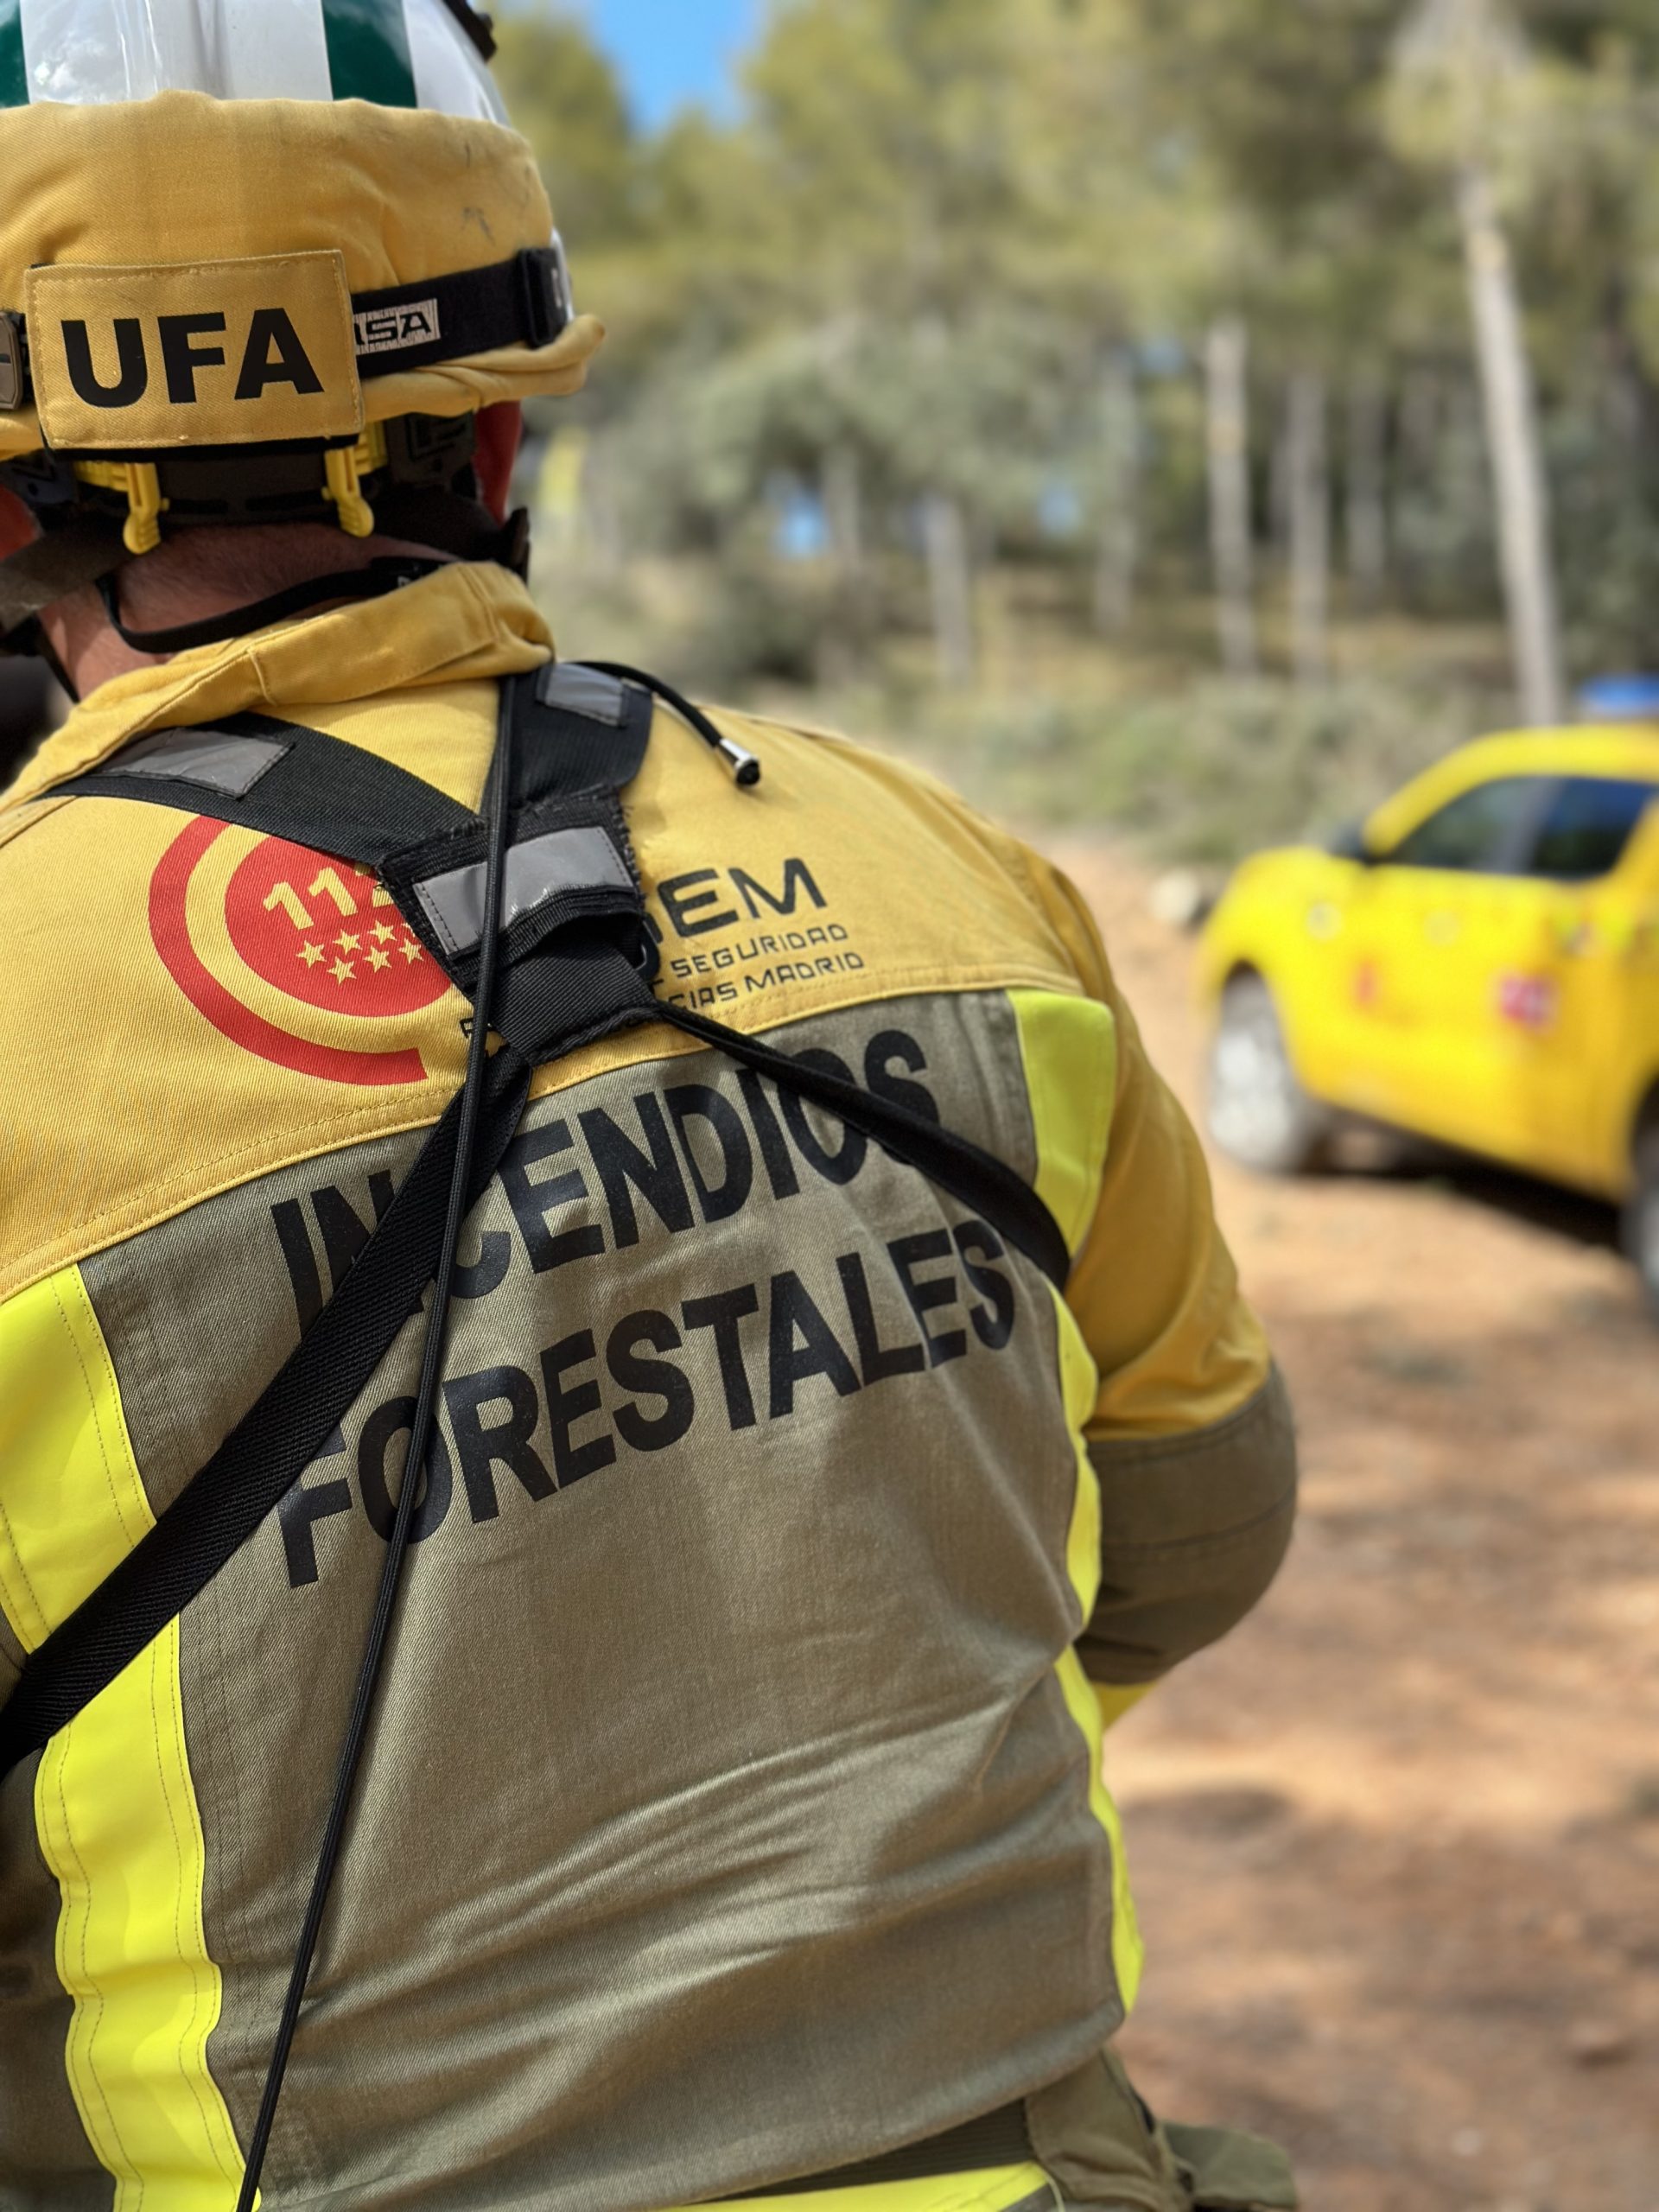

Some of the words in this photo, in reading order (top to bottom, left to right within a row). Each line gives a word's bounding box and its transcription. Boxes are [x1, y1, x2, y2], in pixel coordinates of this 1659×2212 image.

[61, 308, 324, 409] UFA
[654, 857, 827, 944] EM
[671, 924, 849, 978] SEGURIDAD
[744, 951, 864, 993] MADRID
[276, 1218, 1015, 1588] FORESTALES
